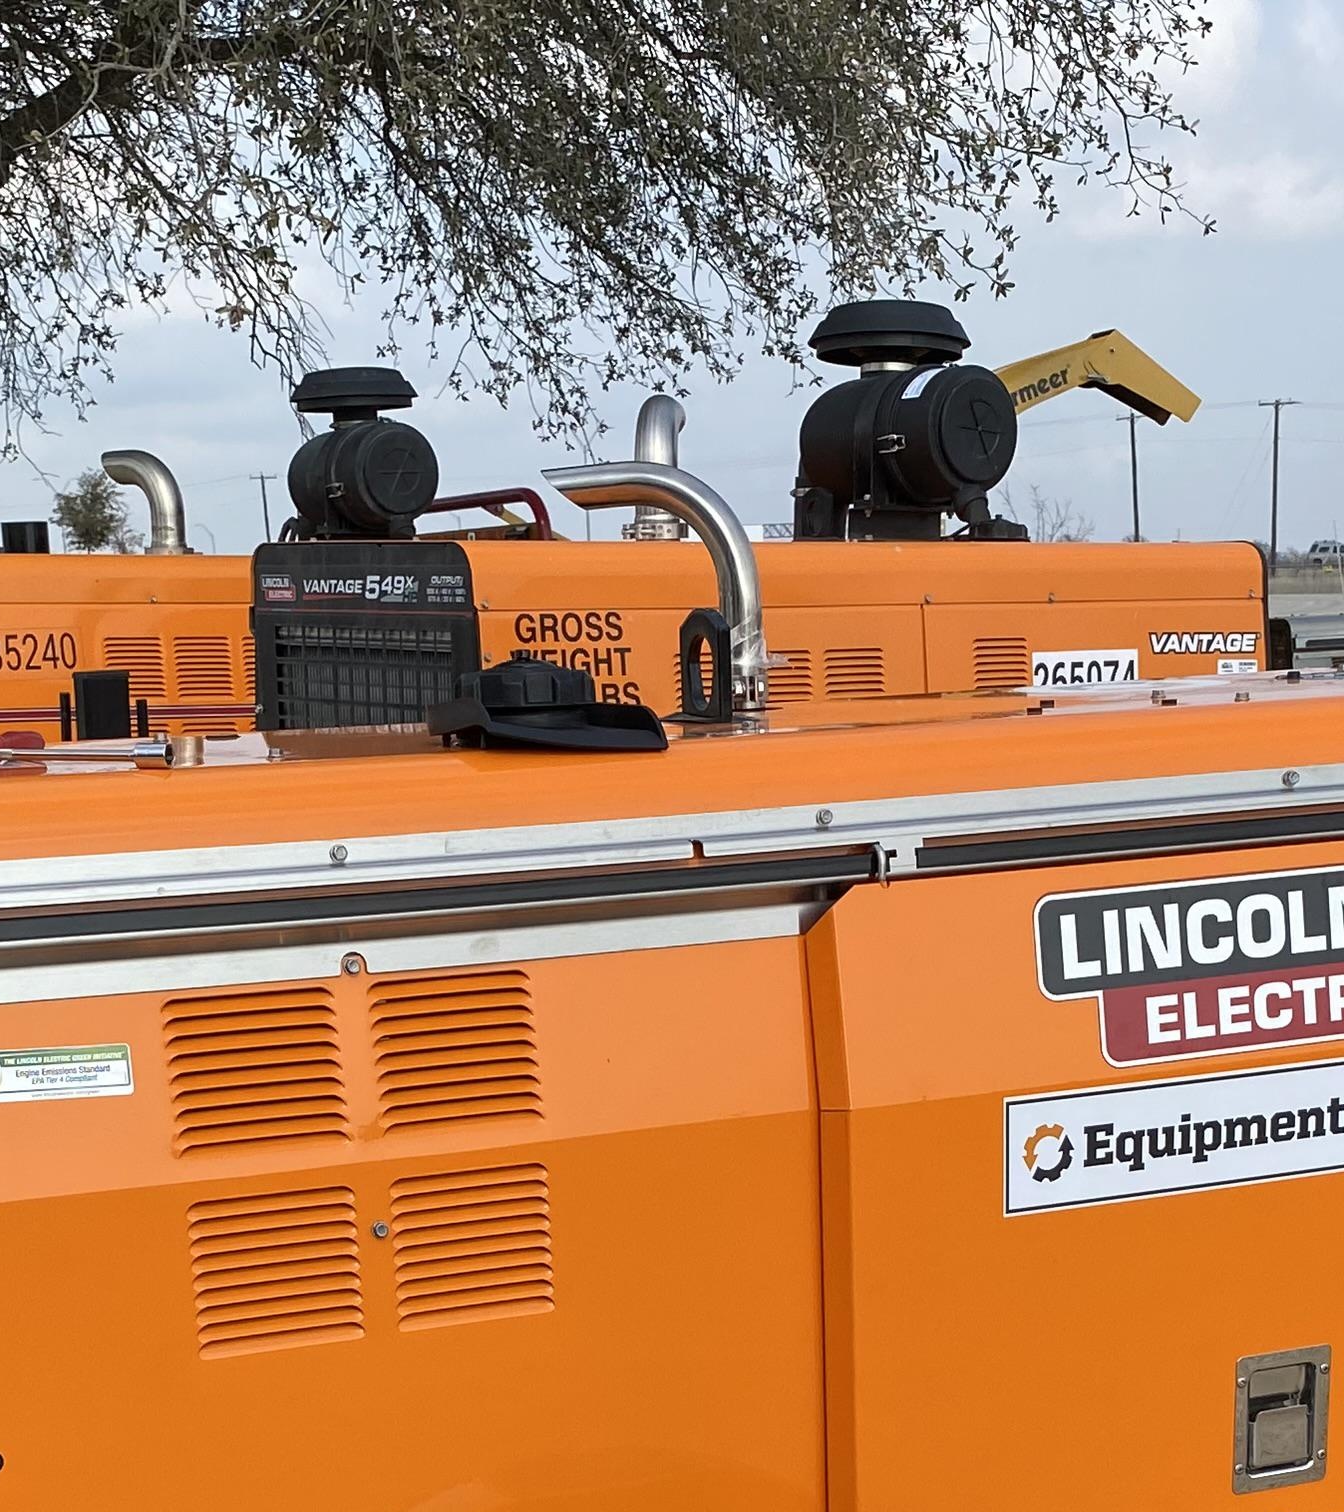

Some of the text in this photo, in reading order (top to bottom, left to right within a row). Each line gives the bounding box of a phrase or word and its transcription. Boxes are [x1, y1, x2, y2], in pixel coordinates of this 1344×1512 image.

[303, 579, 364, 594] VANTAGE
[514, 611, 624, 644] GROSS
[1149, 633, 1257, 653] VANTAGE
[15, 1064, 111, 1079] Engine Emissions Standard
[31, 1077, 45, 1085] EPA
[46, 1076, 58, 1084] Tier
[65, 1074, 98, 1084] Compliant
